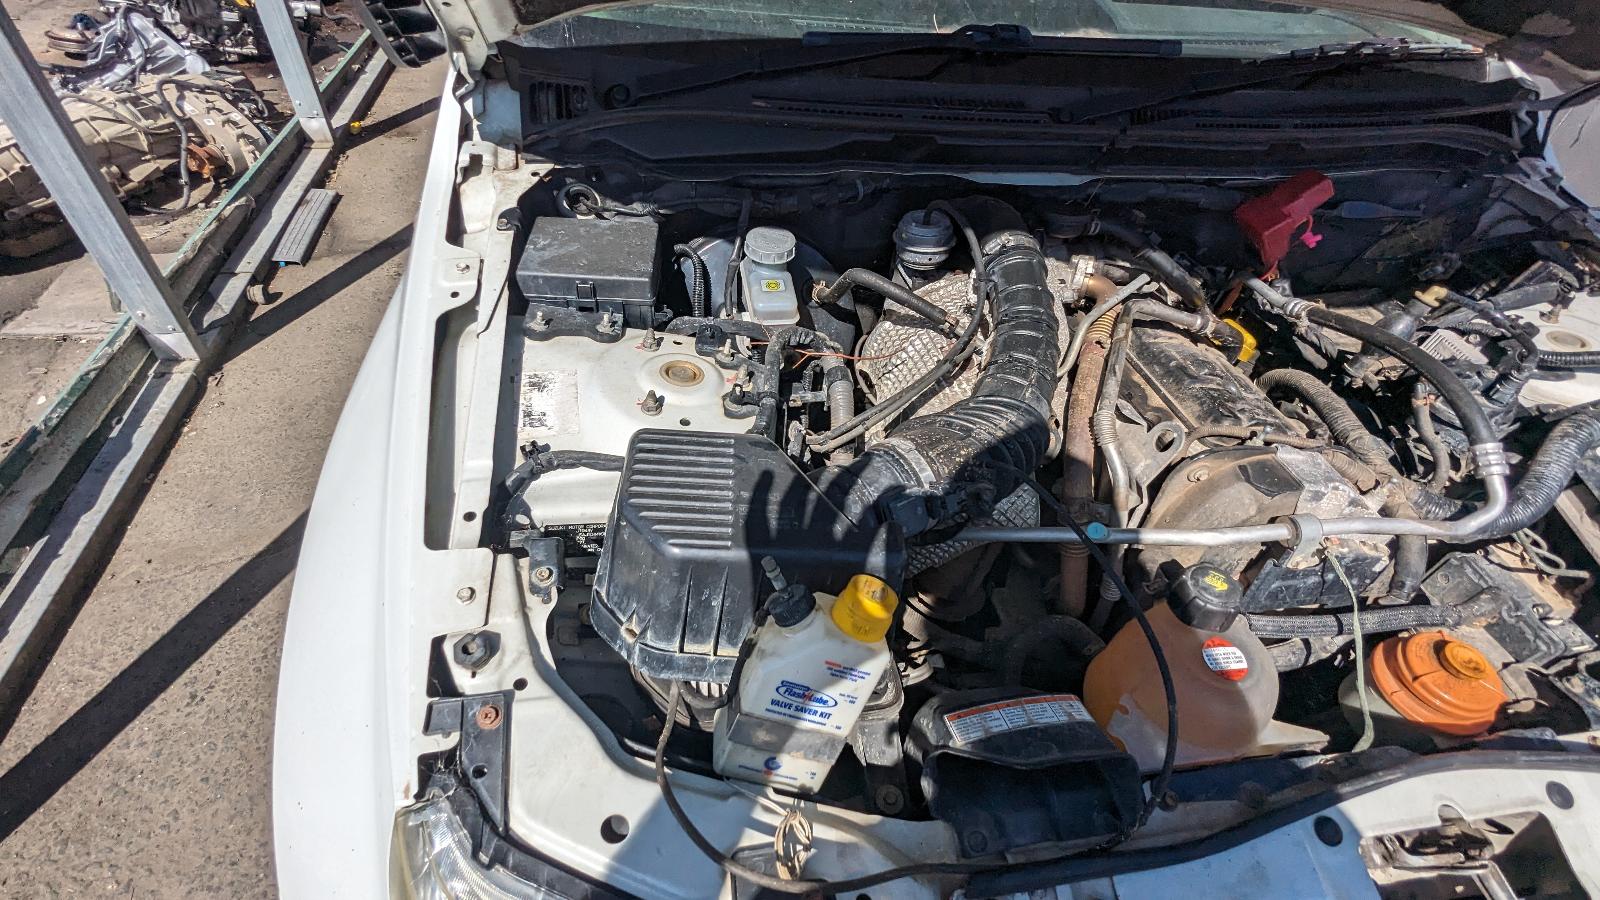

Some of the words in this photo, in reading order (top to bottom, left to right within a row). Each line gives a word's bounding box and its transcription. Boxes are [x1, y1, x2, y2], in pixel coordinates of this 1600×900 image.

[770, 698, 793, 710] VALVE
[793, 704, 818, 717] SAVER
[818, 711, 832, 720] KIT
